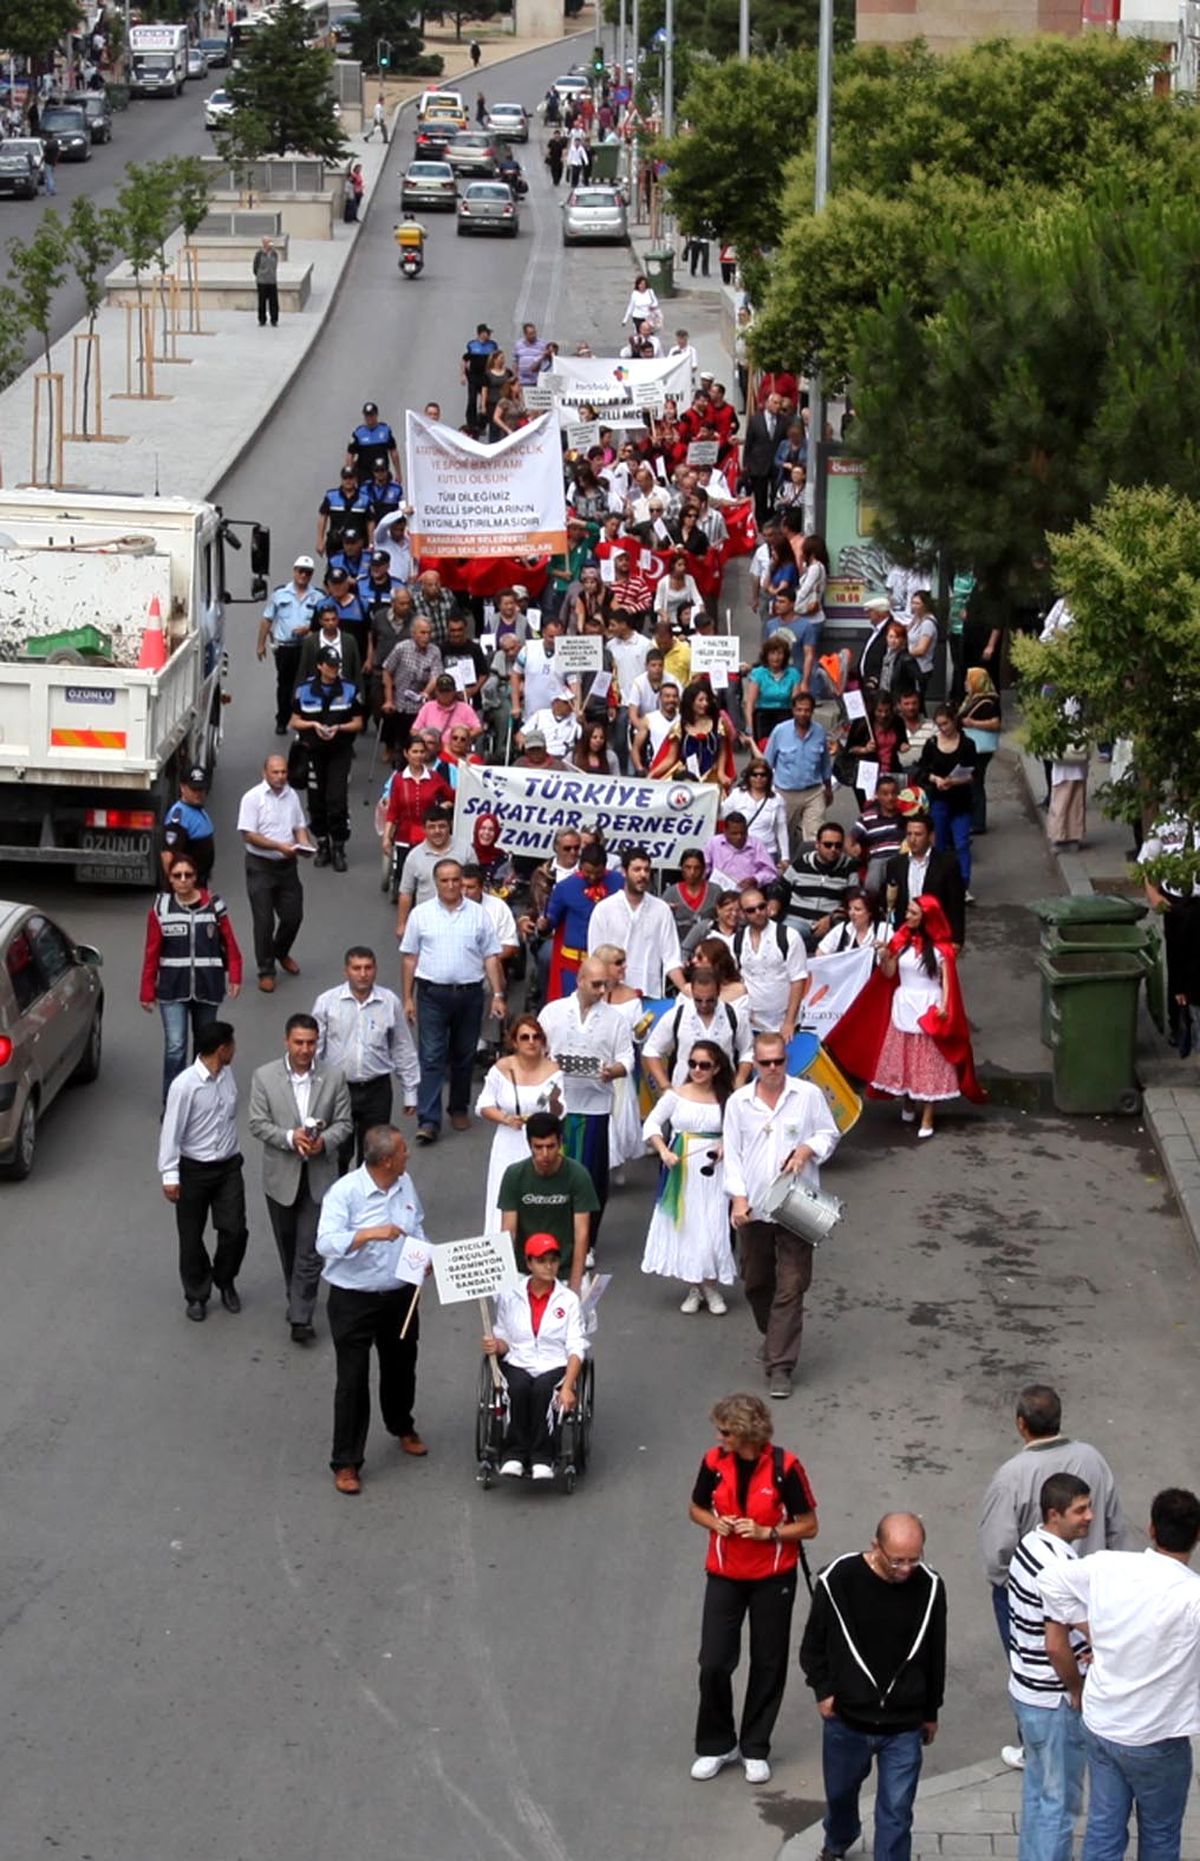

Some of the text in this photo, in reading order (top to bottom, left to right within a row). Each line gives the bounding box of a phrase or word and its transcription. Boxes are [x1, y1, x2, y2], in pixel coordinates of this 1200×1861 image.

[438, 490, 511, 502] TÜM DİLEĞİMİZ
[424, 504, 535, 516] ENGELLİ SPORLARININ
[524, 775, 654, 808] TÜRKİYE
[463, 797, 705, 836] SAKATLAR DERNEĞİ
[499, 823, 556, 850] İZMİ
[456, 1274, 502, 1289] SANDALYE
